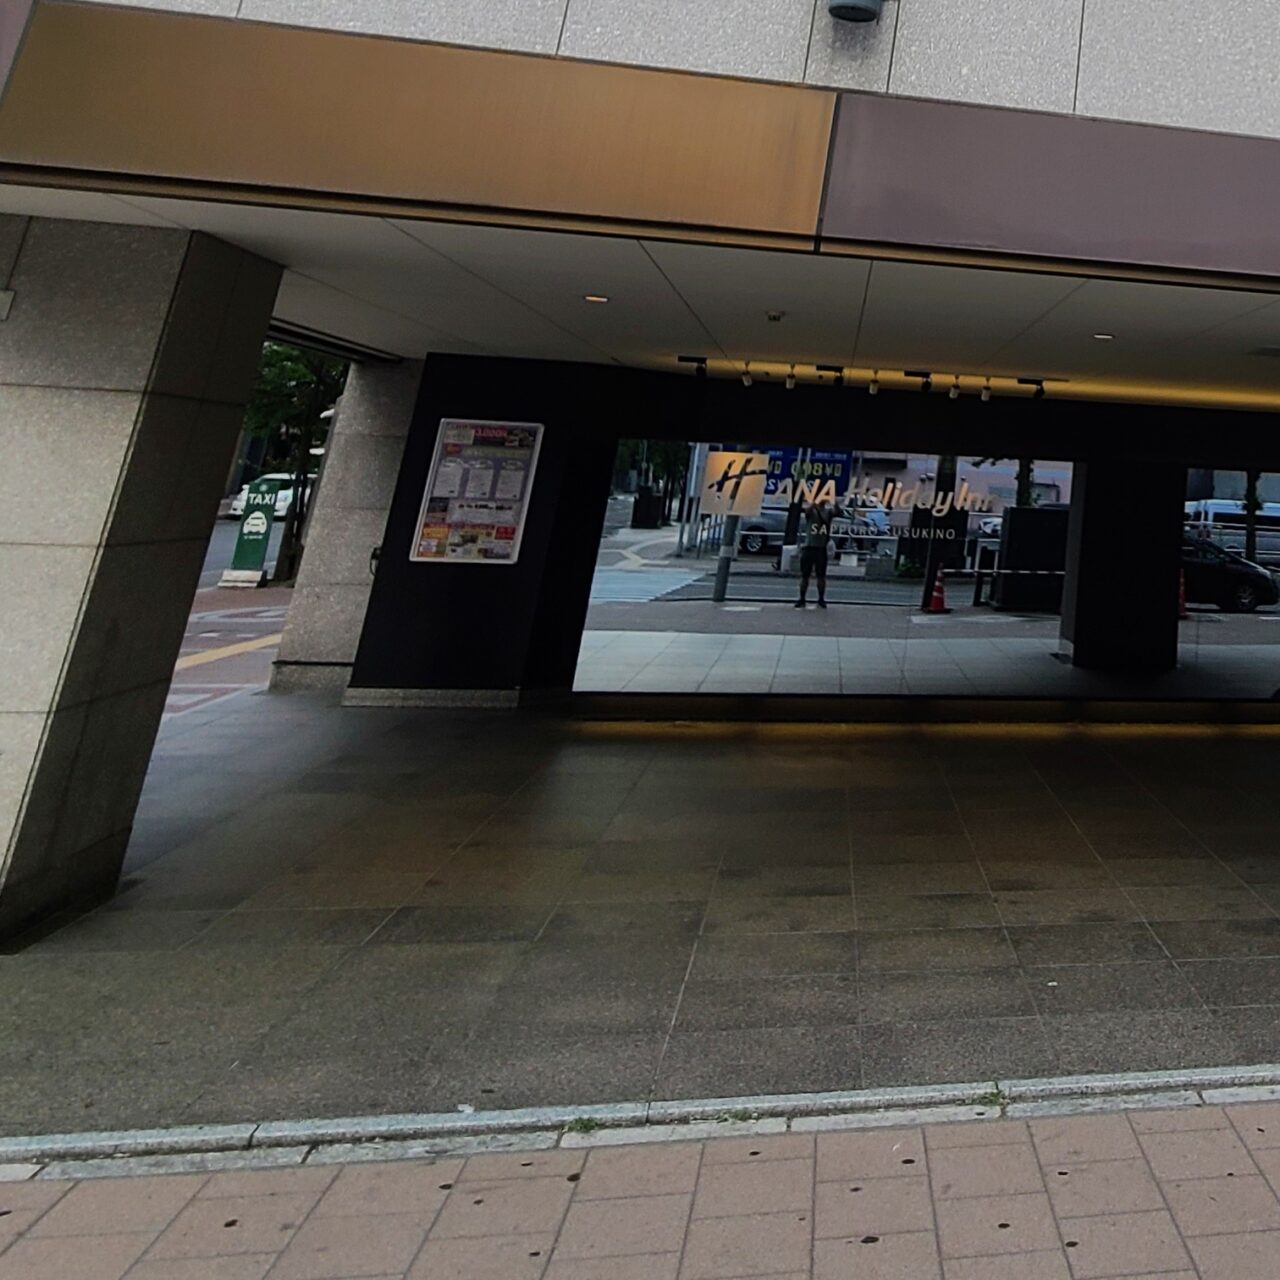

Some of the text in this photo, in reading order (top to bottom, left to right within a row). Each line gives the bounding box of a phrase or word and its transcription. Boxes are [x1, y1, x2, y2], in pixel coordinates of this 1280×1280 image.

[249, 493, 276, 505] TAXI
[774, 478, 836, 505] ANA
[844, 477, 954, 517] Holiday
[810, 523, 956, 540] SAPPORO SUSUKINO
